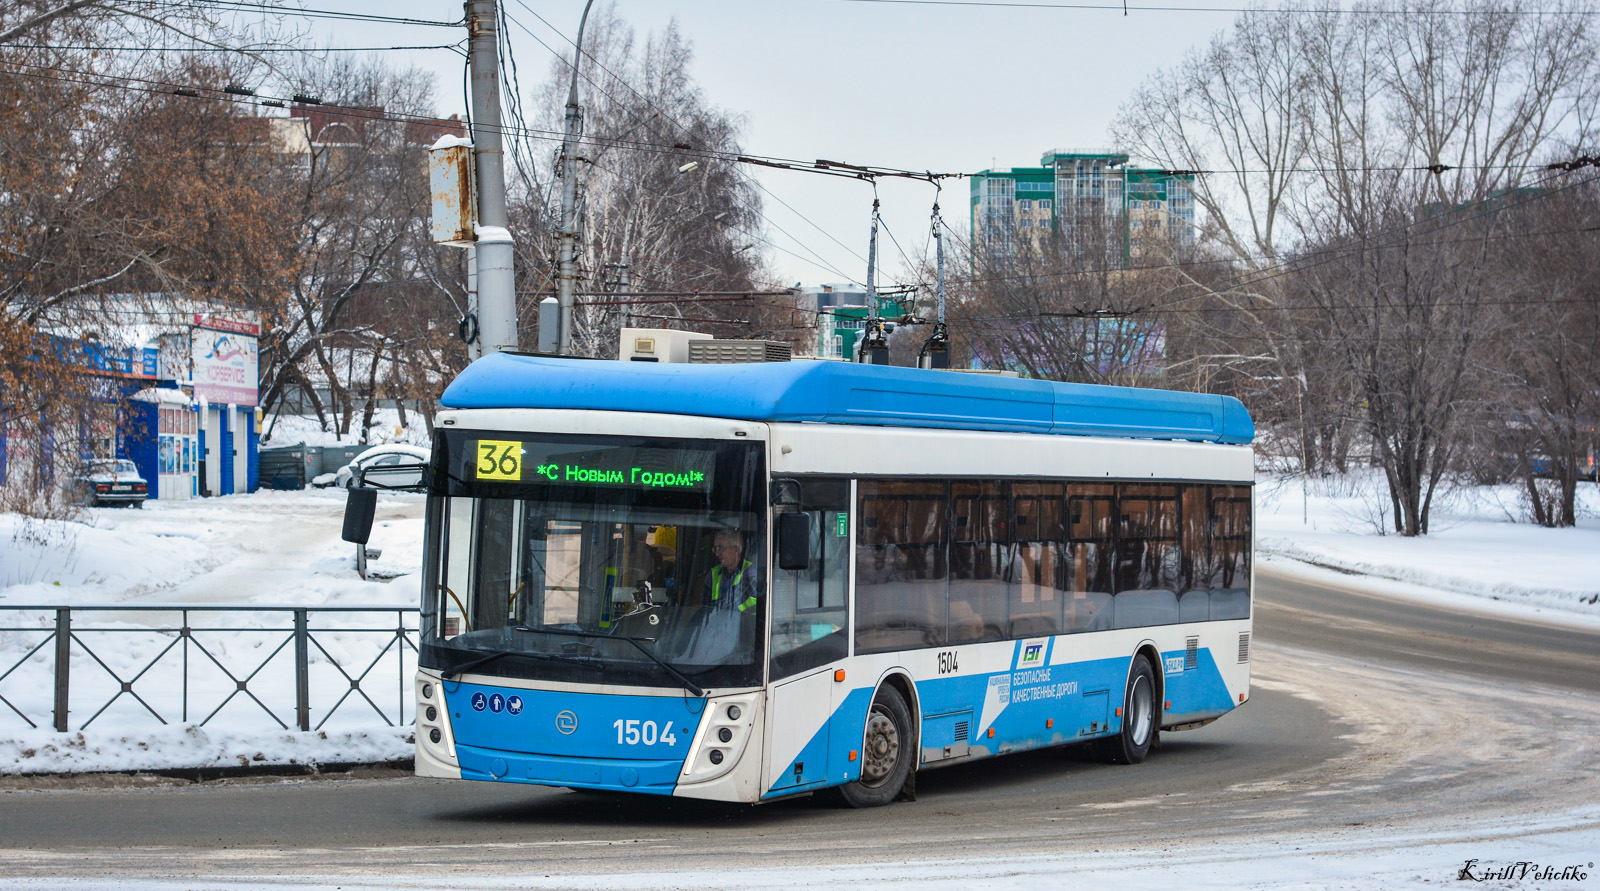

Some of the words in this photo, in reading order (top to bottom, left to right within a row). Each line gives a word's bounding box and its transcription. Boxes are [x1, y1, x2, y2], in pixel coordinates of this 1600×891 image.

[478, 444, 518, 476] 36
[565, 465, 624, 484] Новым
[937, 650, 959, 675] 1504
[1013, 668, 1052, 686] БЕЗОПАСНЫЕ
[1012, 684, 1056, 704] КАЧЕСТВЕННЫЕ
[1056, 681, 1078, 700] ДОРОГИ
[613, 719, 677, 747] 1504
